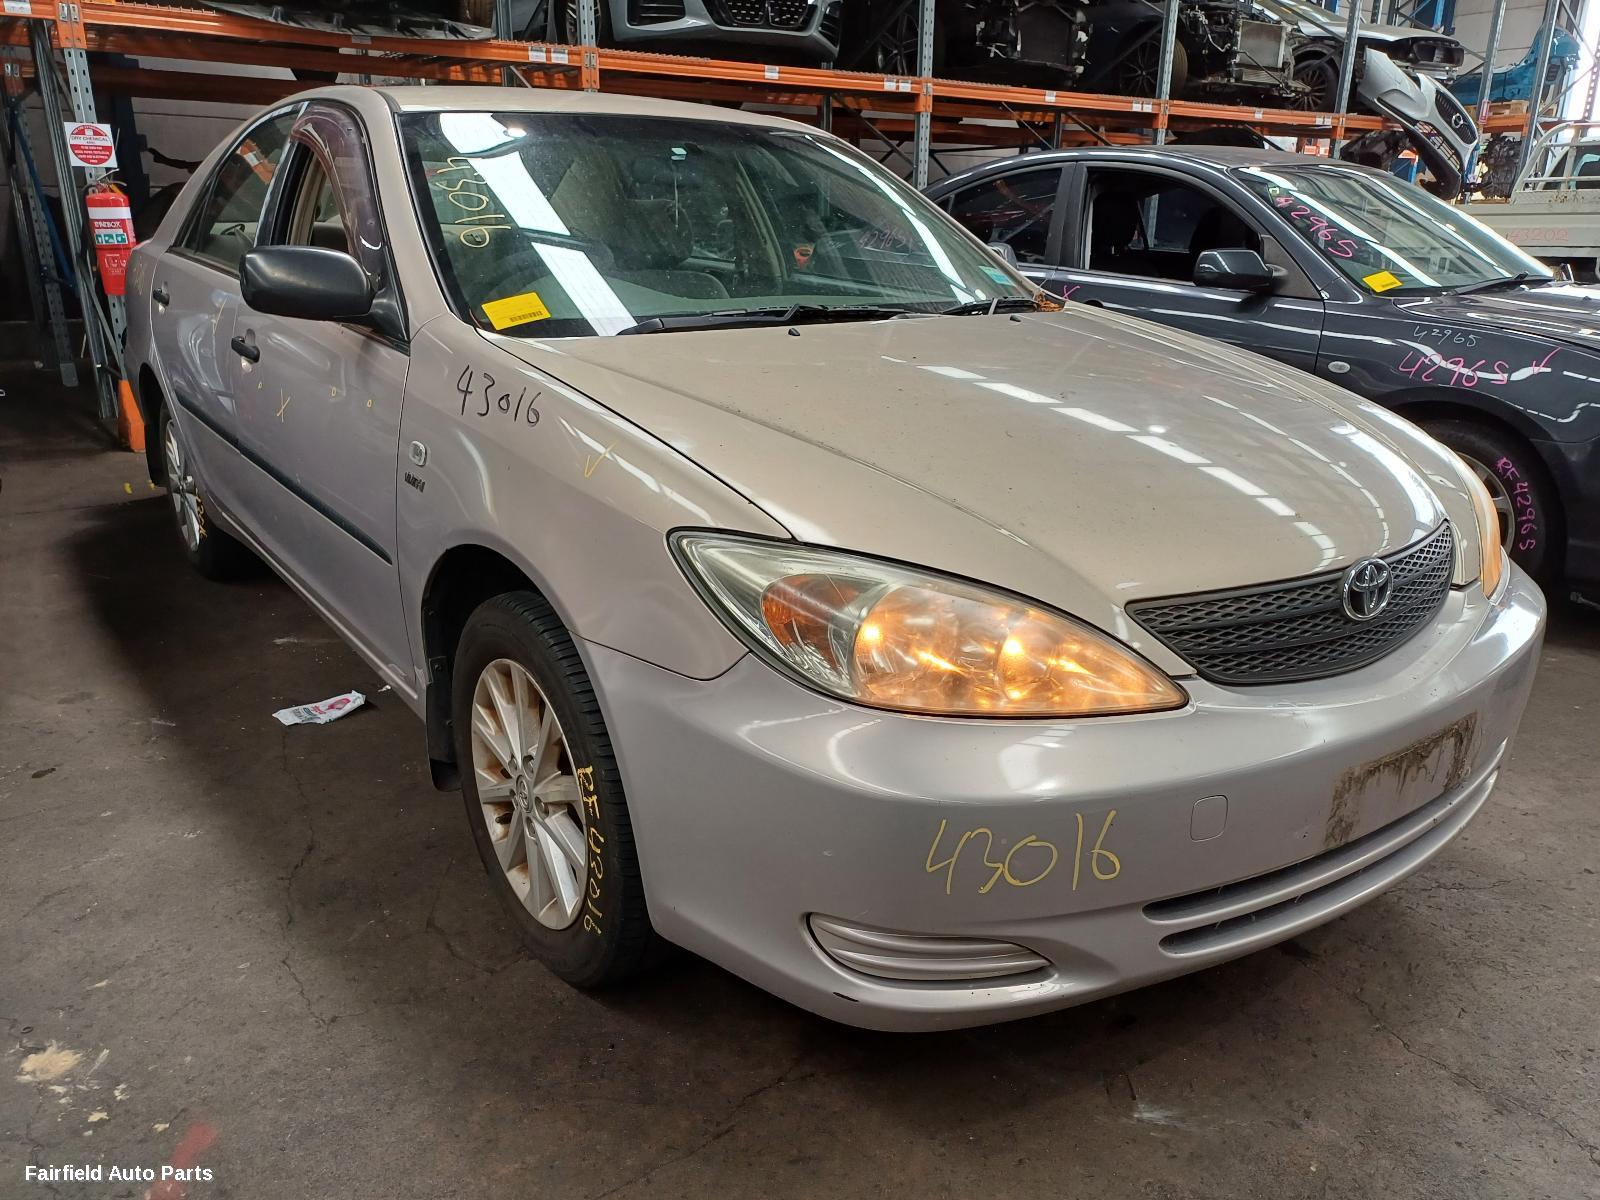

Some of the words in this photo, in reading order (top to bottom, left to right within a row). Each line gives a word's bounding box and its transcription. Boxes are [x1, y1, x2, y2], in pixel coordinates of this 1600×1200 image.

[435, 157, 512, 248] 43016
[1276, 197, 1359, 257] 42965
[1412, 325, 1482, 347] 42965
[456, 364, 542, 428] 43016
[1398, 351, 1509, 387] 42965
[925, 809, 1121, 895] 43016
